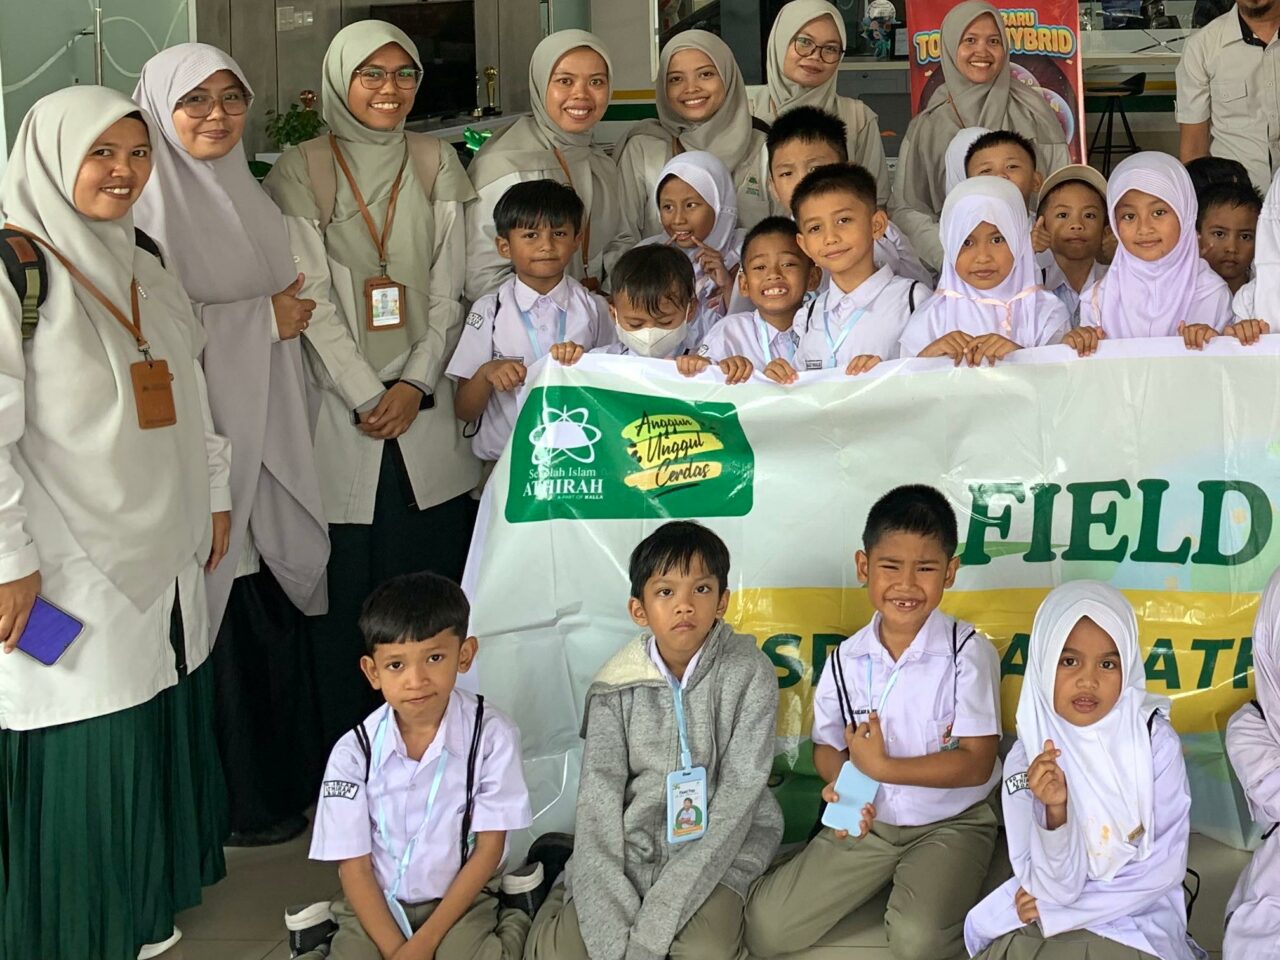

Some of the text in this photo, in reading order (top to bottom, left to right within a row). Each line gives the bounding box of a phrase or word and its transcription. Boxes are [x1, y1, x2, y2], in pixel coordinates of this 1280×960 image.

[636, 411, 693, 436] Anggun
[569, 466, 596, 477] Islam
[656, 459, 710, 487] Cerdas
[961, 478, 1273, 566] FIELD
